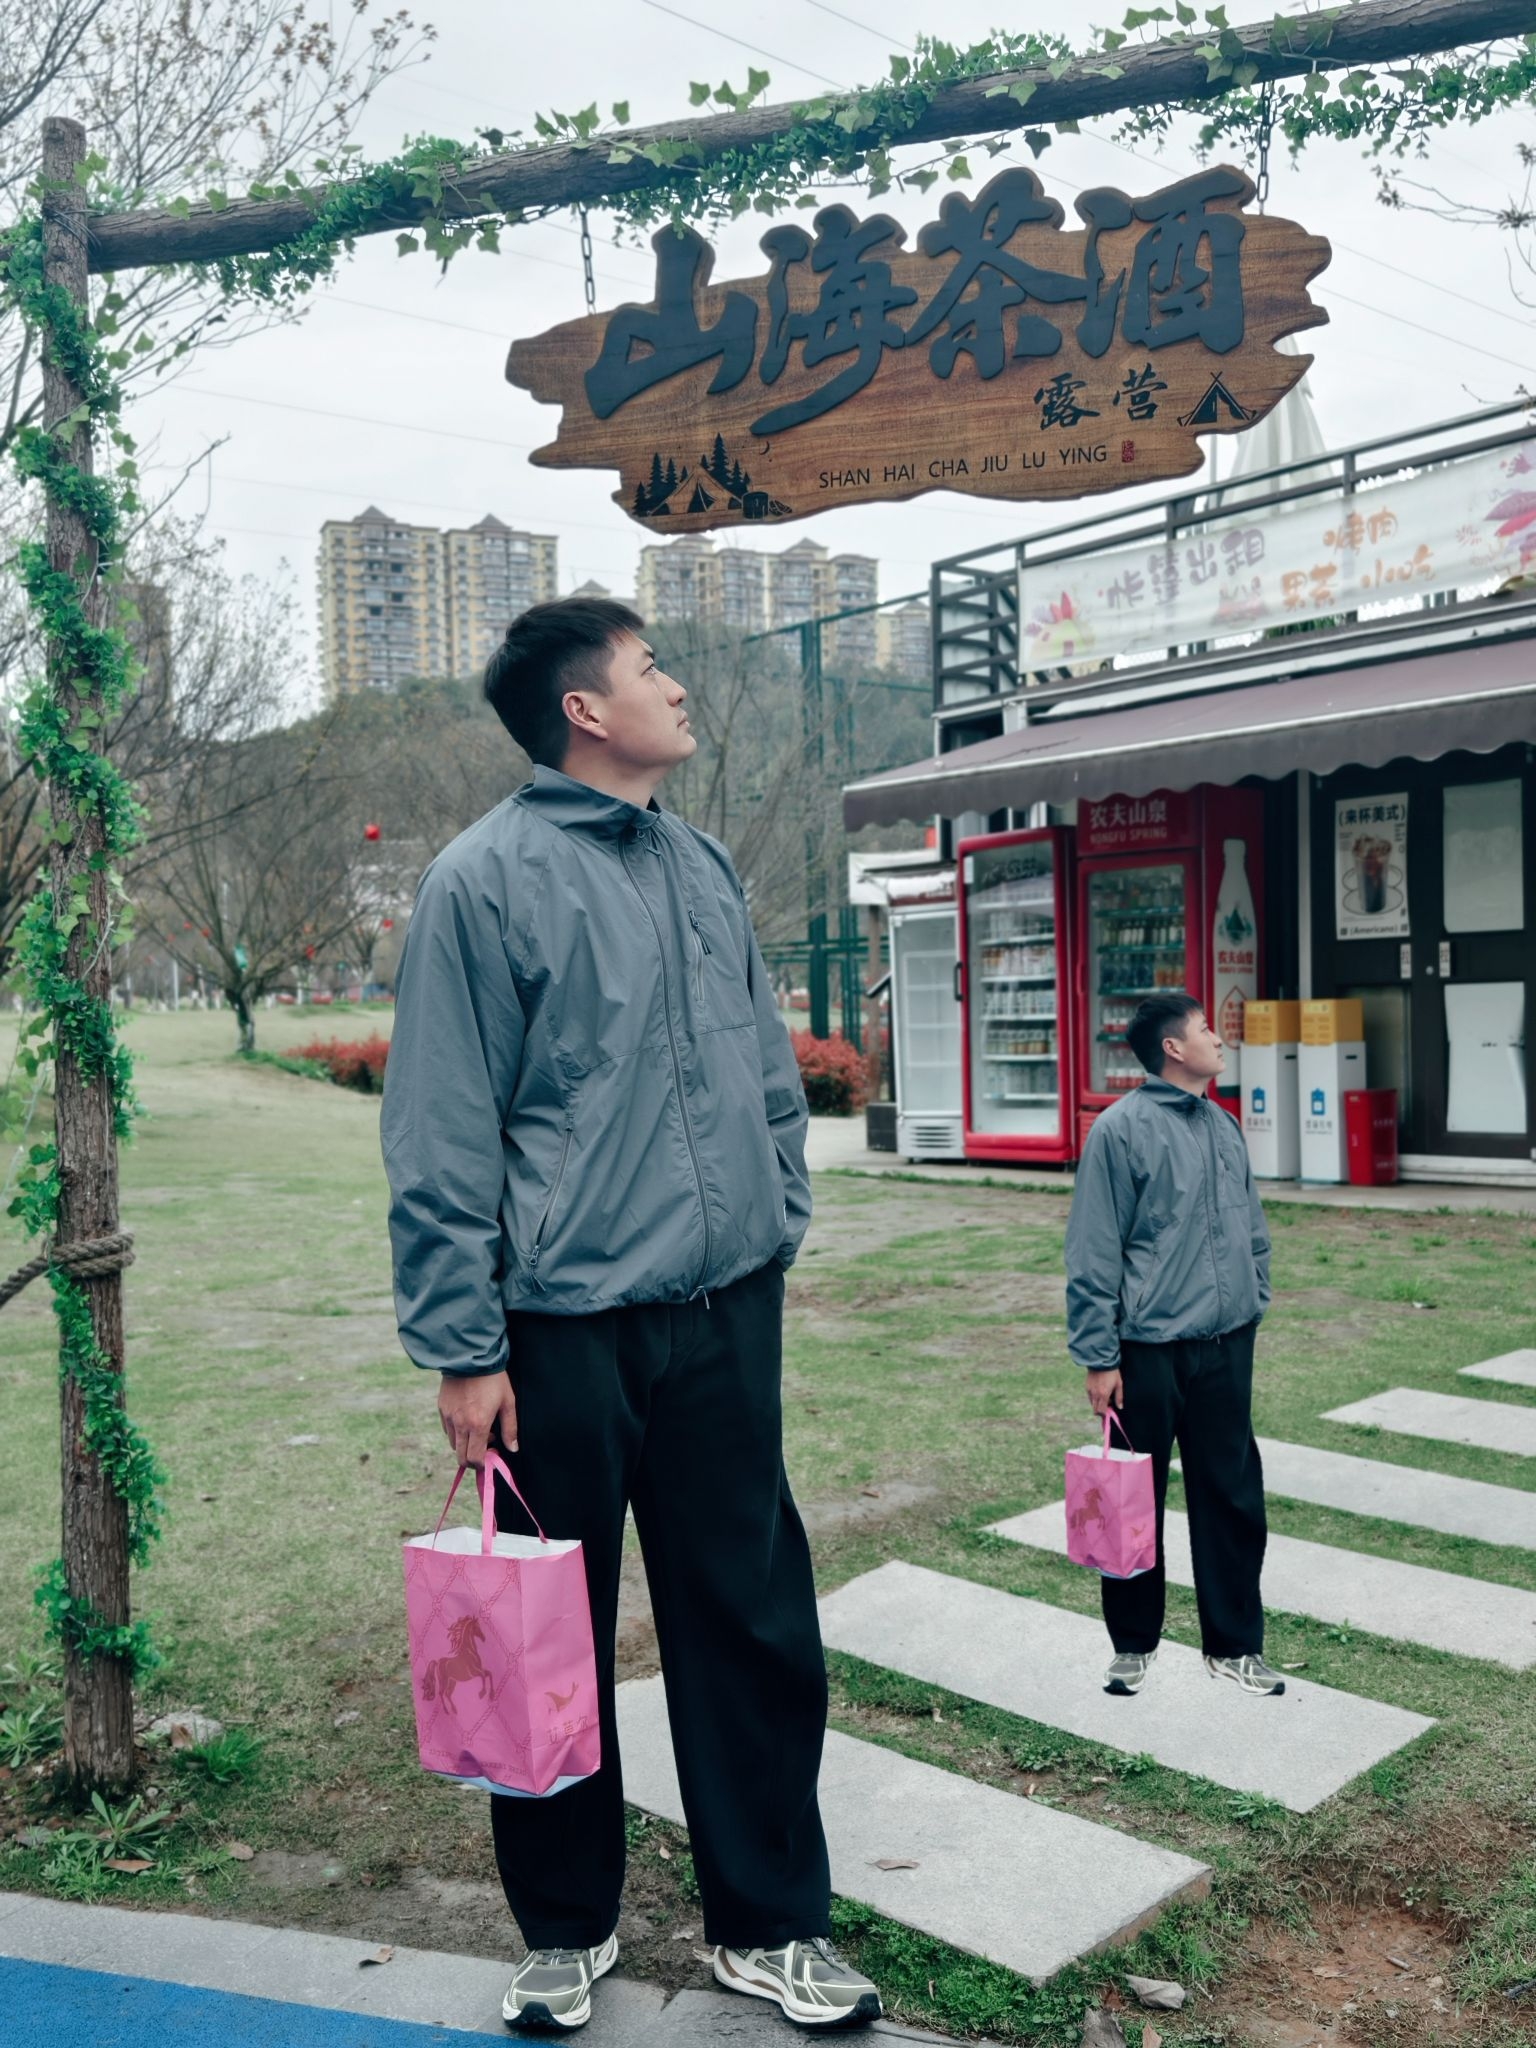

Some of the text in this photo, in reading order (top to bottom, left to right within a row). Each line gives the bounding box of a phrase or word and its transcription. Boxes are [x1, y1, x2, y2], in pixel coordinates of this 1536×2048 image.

[584, 165, 1253, 435] 山海茶酒
[1033, 363, 1168, 430] 露营
[819, 468, 870, 489] SHAN
[884, 464, 915, 482] HAI
[928, 459, 969, 478] CHA
[981, 455, 1008, 473] JIU
[1022, 451, 1046, 469] LU
[1059, 445, 1107, 466] YING
[1281, 562, 1338, 610] 果茶
[1361, 544, 1436, 588] 小吃
[1090, 800, 1167, 829] 农夫山泉
[1129, 827, 1168, 841] SPRING
